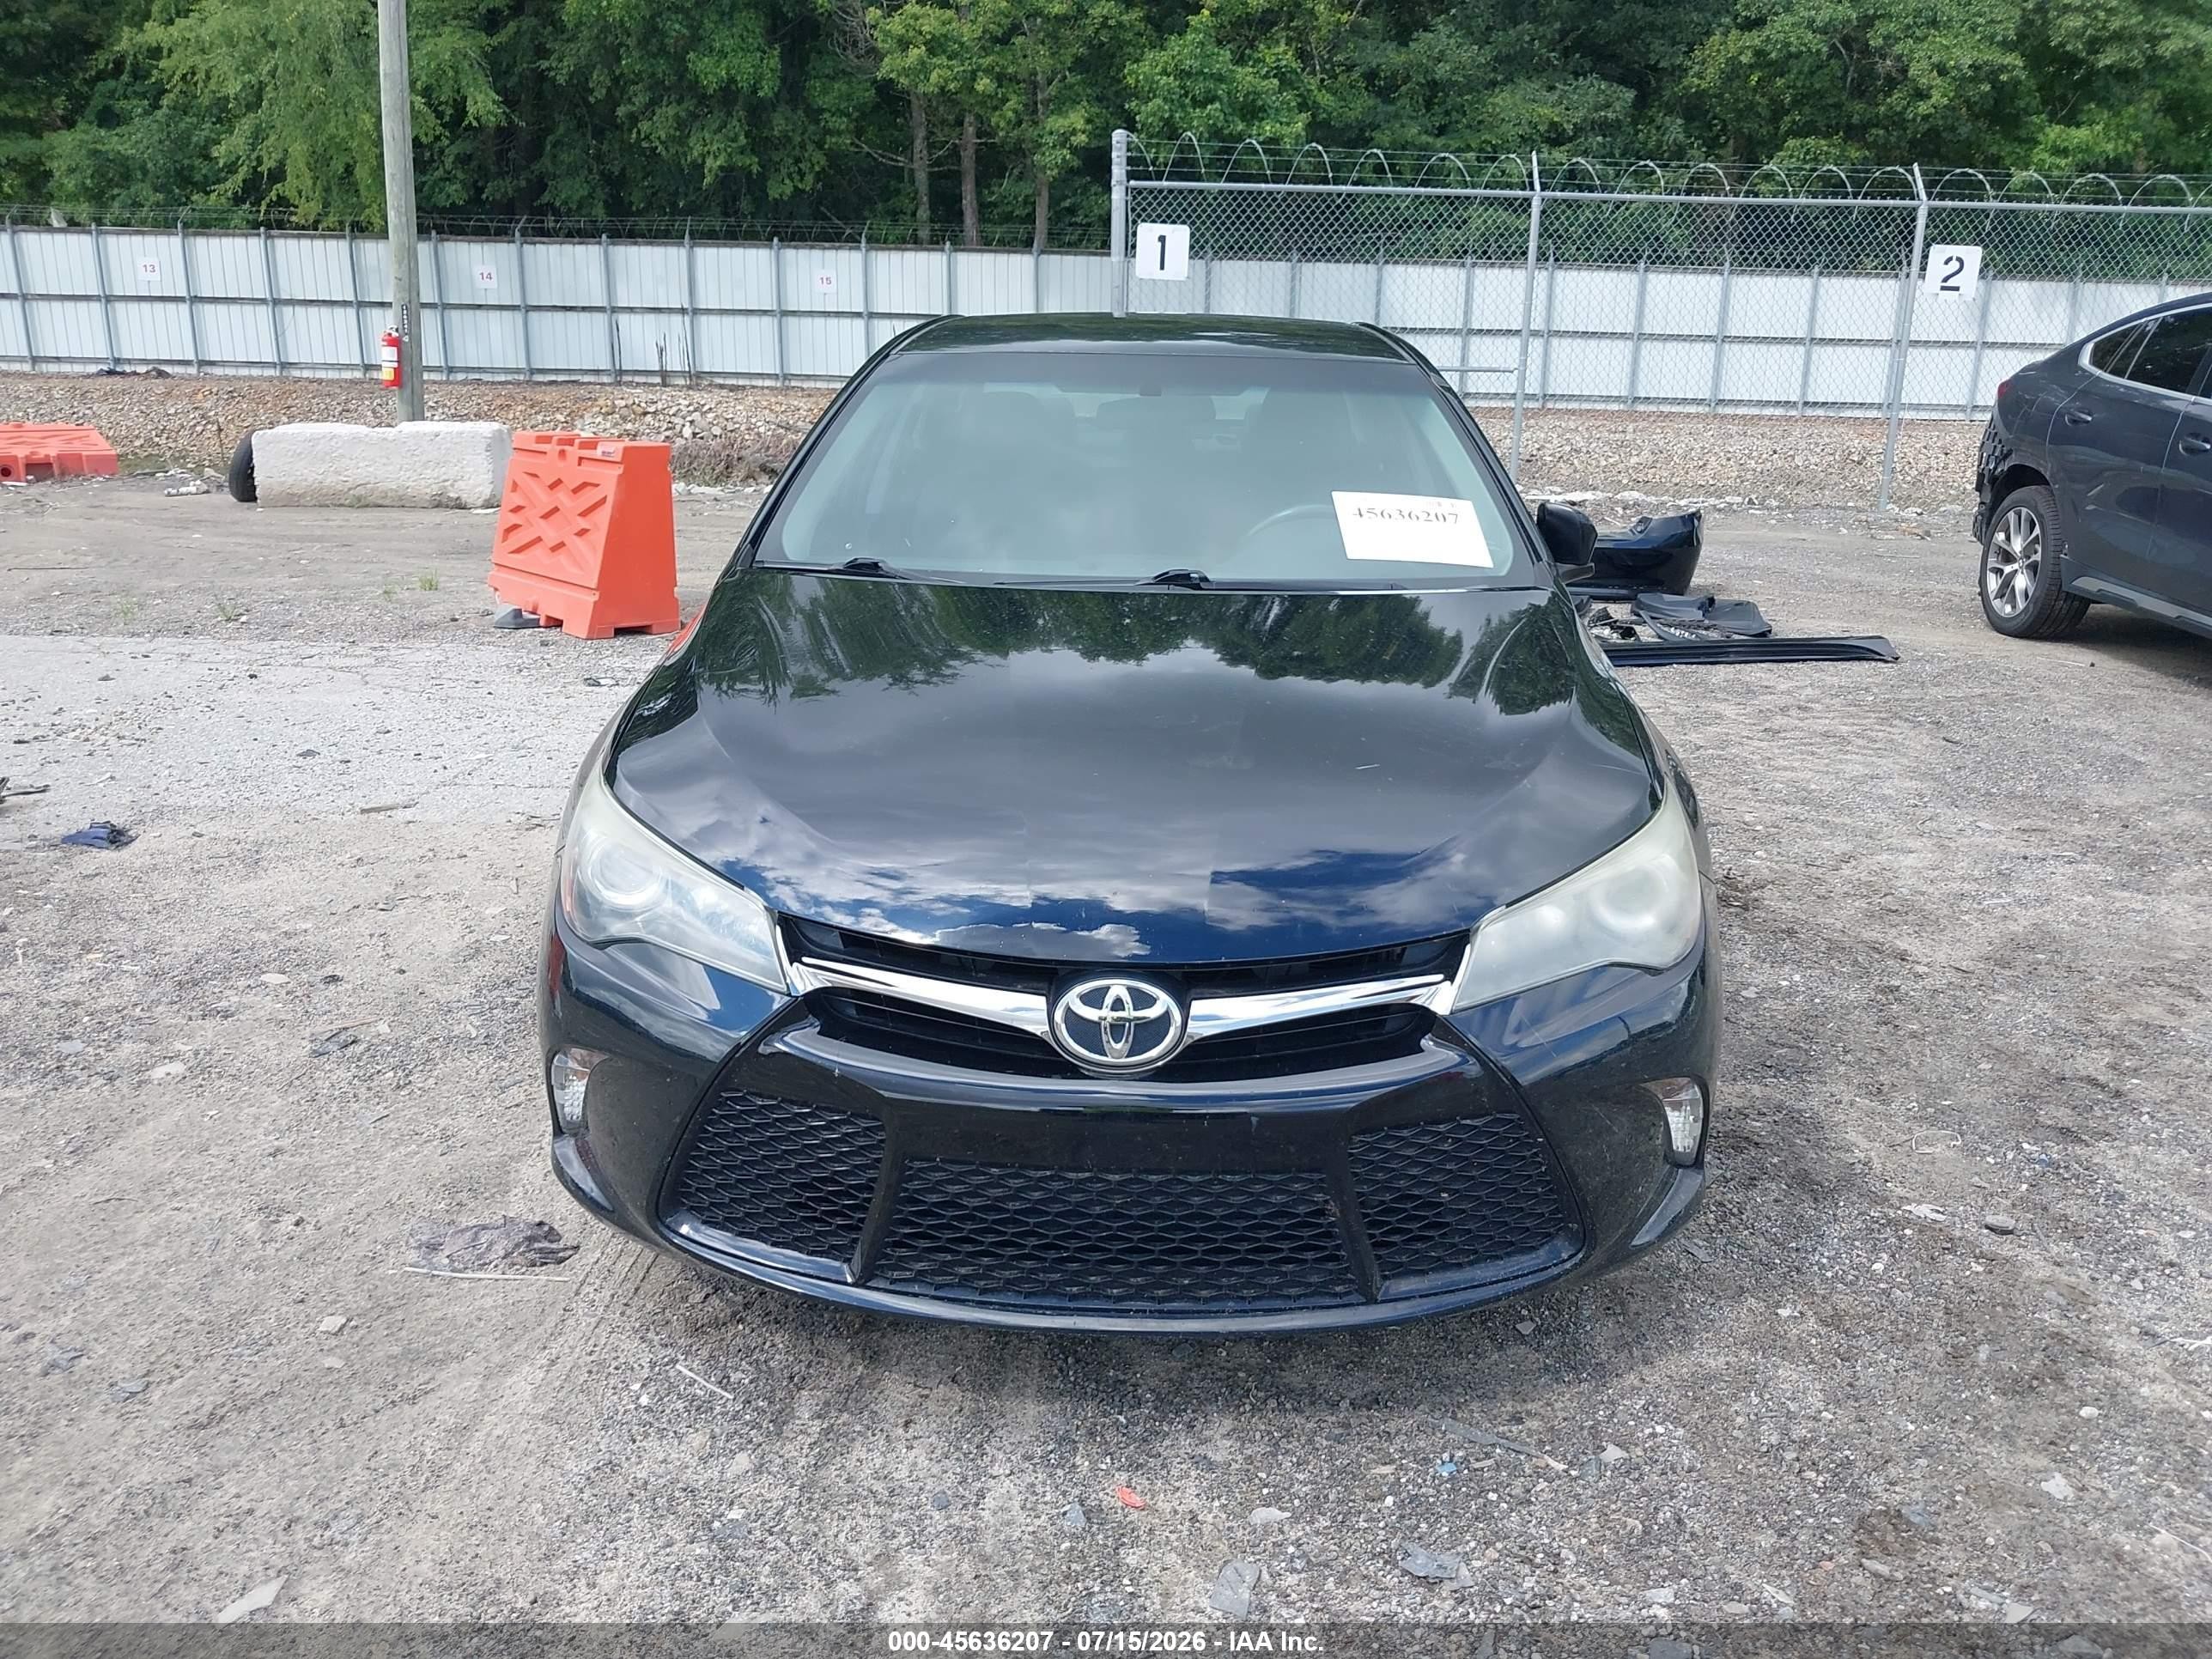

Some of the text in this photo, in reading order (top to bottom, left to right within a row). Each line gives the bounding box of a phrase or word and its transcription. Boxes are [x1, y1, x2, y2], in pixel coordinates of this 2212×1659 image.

[1158, 234, 1166, 270] 1
[143, 264, 156, 273] 13
[1940, 255, 1965, 292] 2
[479, 271, 493, 281] 14
[819, 276, 832, 285] 15
[1352, 507, 1459, 525] 45636207
